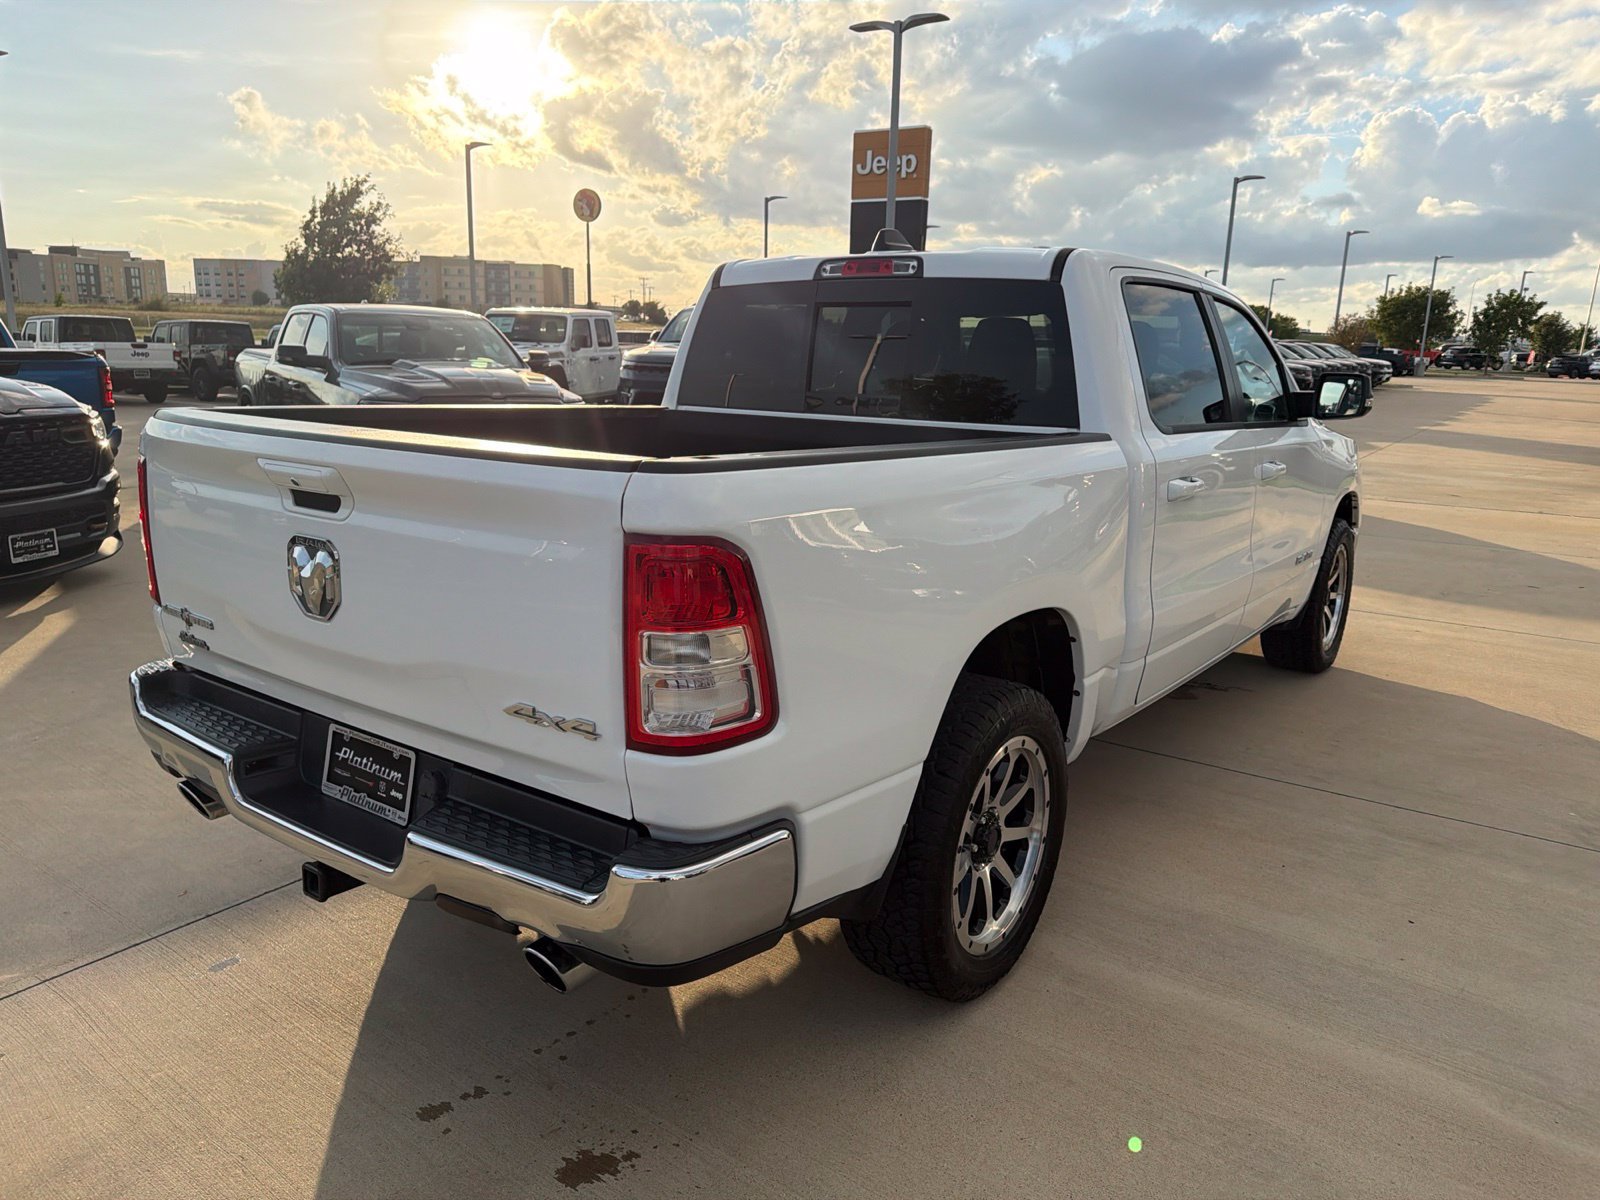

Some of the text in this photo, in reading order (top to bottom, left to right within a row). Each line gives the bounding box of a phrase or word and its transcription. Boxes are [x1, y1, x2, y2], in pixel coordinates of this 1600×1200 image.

[130, 350, 150, 359] Jeep
[335, 746, 405, 786] Platinum
[339, 785, 389, 818] Platinum
[389, 787, 404, 801] Jeep
